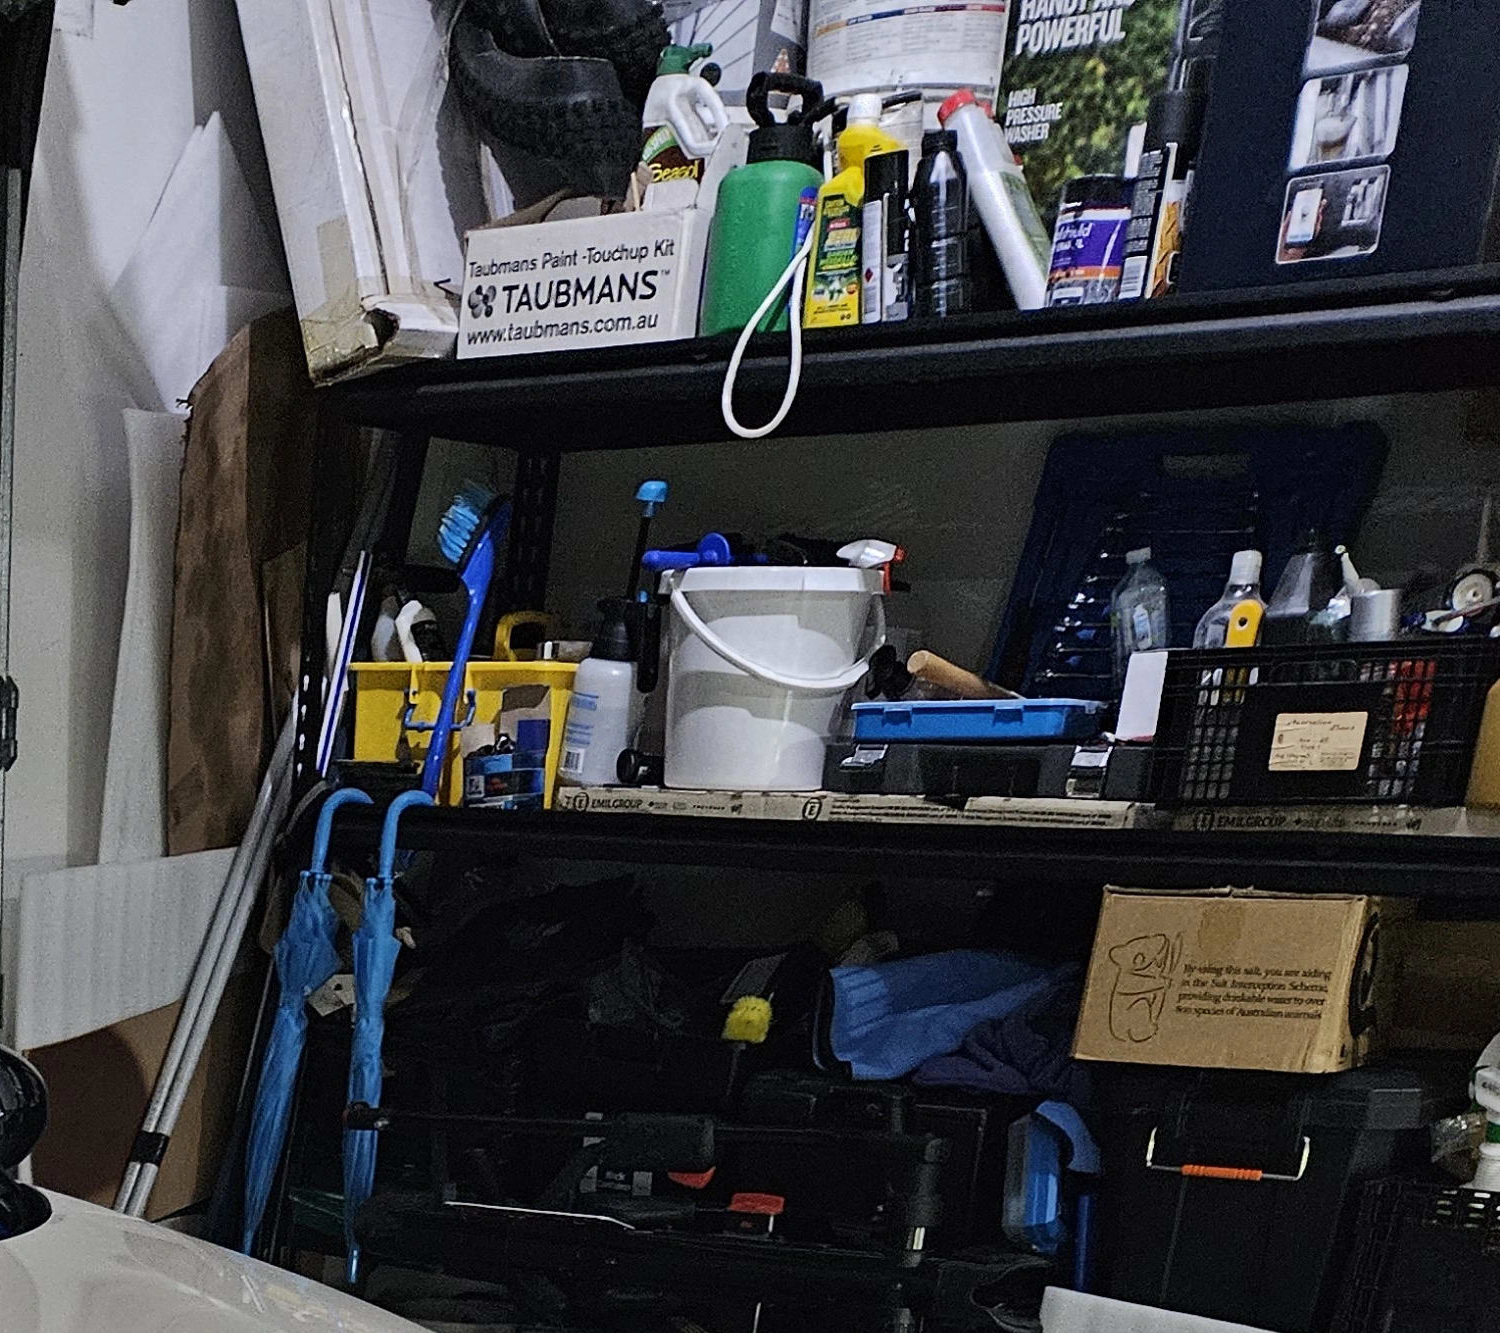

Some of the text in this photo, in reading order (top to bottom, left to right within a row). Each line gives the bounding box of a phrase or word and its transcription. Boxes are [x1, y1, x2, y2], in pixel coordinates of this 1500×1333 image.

[1015, 8, 1126, 57] POWERFUL
[1006, 102, 1063, 127] PRESSURE
[1008, 88, 1037, 108] HIGH
[1004, 122, 1050, 144] WASHER
[468, 256, 537, 278] Taubmans
[541, 248, 577, 270] Paint
[653, 238, 676, 258] Kit
[502, 269, 659, 314] TAUBMANS
[467, 312, 660, 346] www.taubmans.com.au
